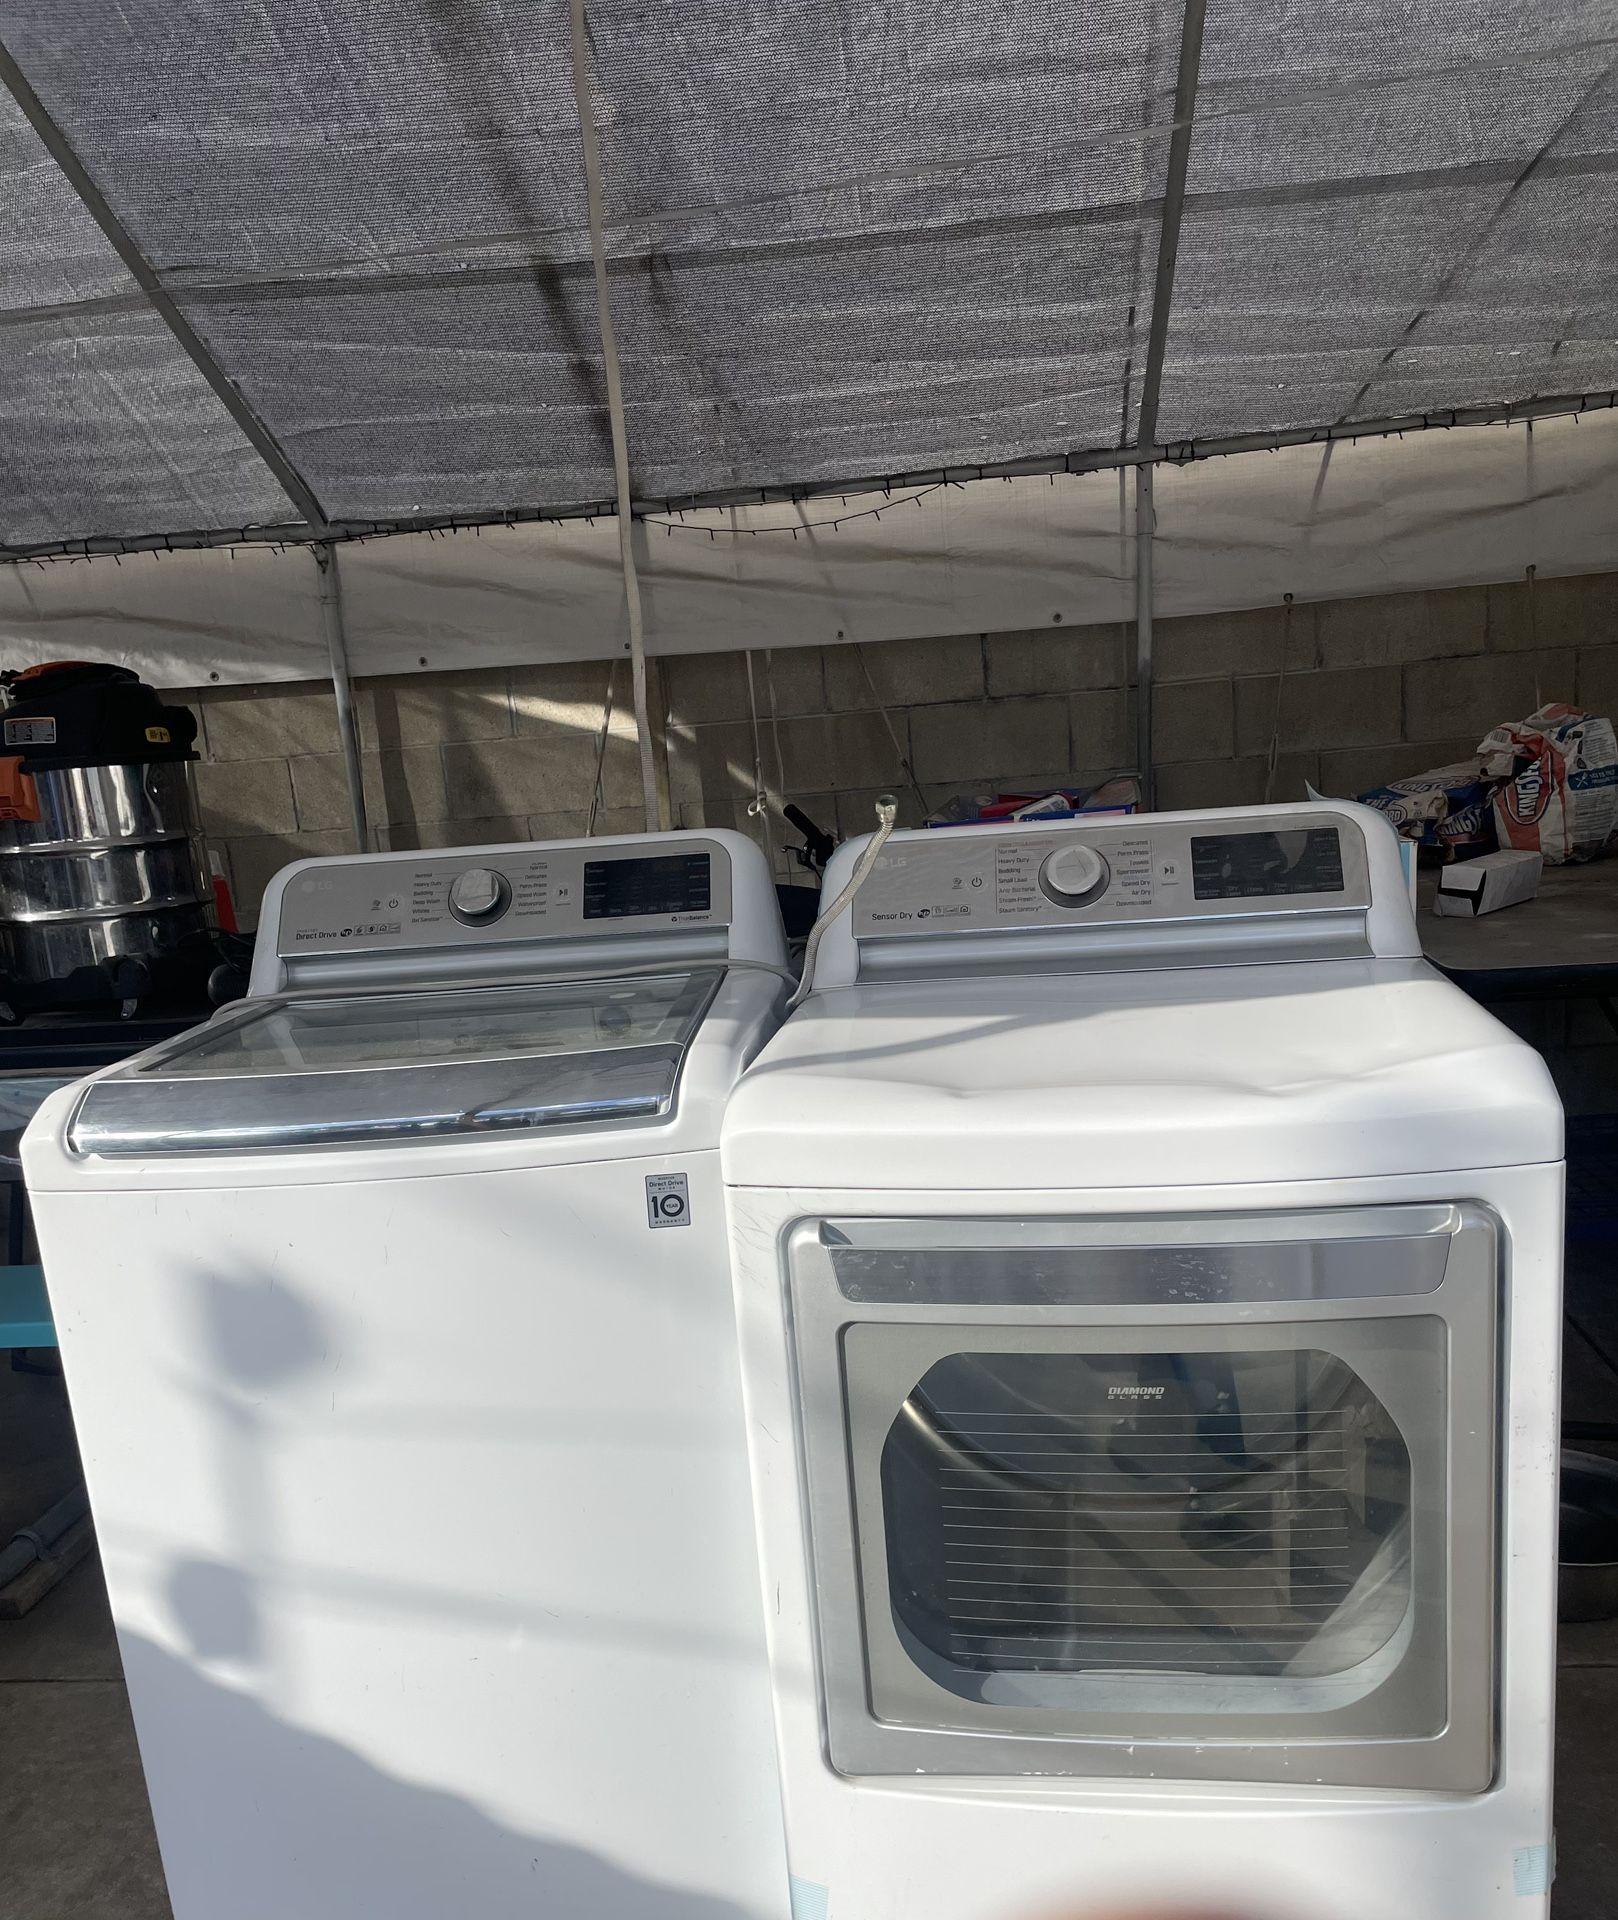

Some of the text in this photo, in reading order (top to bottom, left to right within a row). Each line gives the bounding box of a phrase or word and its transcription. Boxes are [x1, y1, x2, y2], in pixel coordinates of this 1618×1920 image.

[1515, 759, 1544, 817] KINGSFO
[890, 857, 907, 868] LG
[871, 912, 899, 921] Sensor
[899, 911, 913, 921] Dry
[295, 932, 317, 941] Direct
[318, 930, 337, 939] Drive
[651, 1194, 685, 1218] 10
